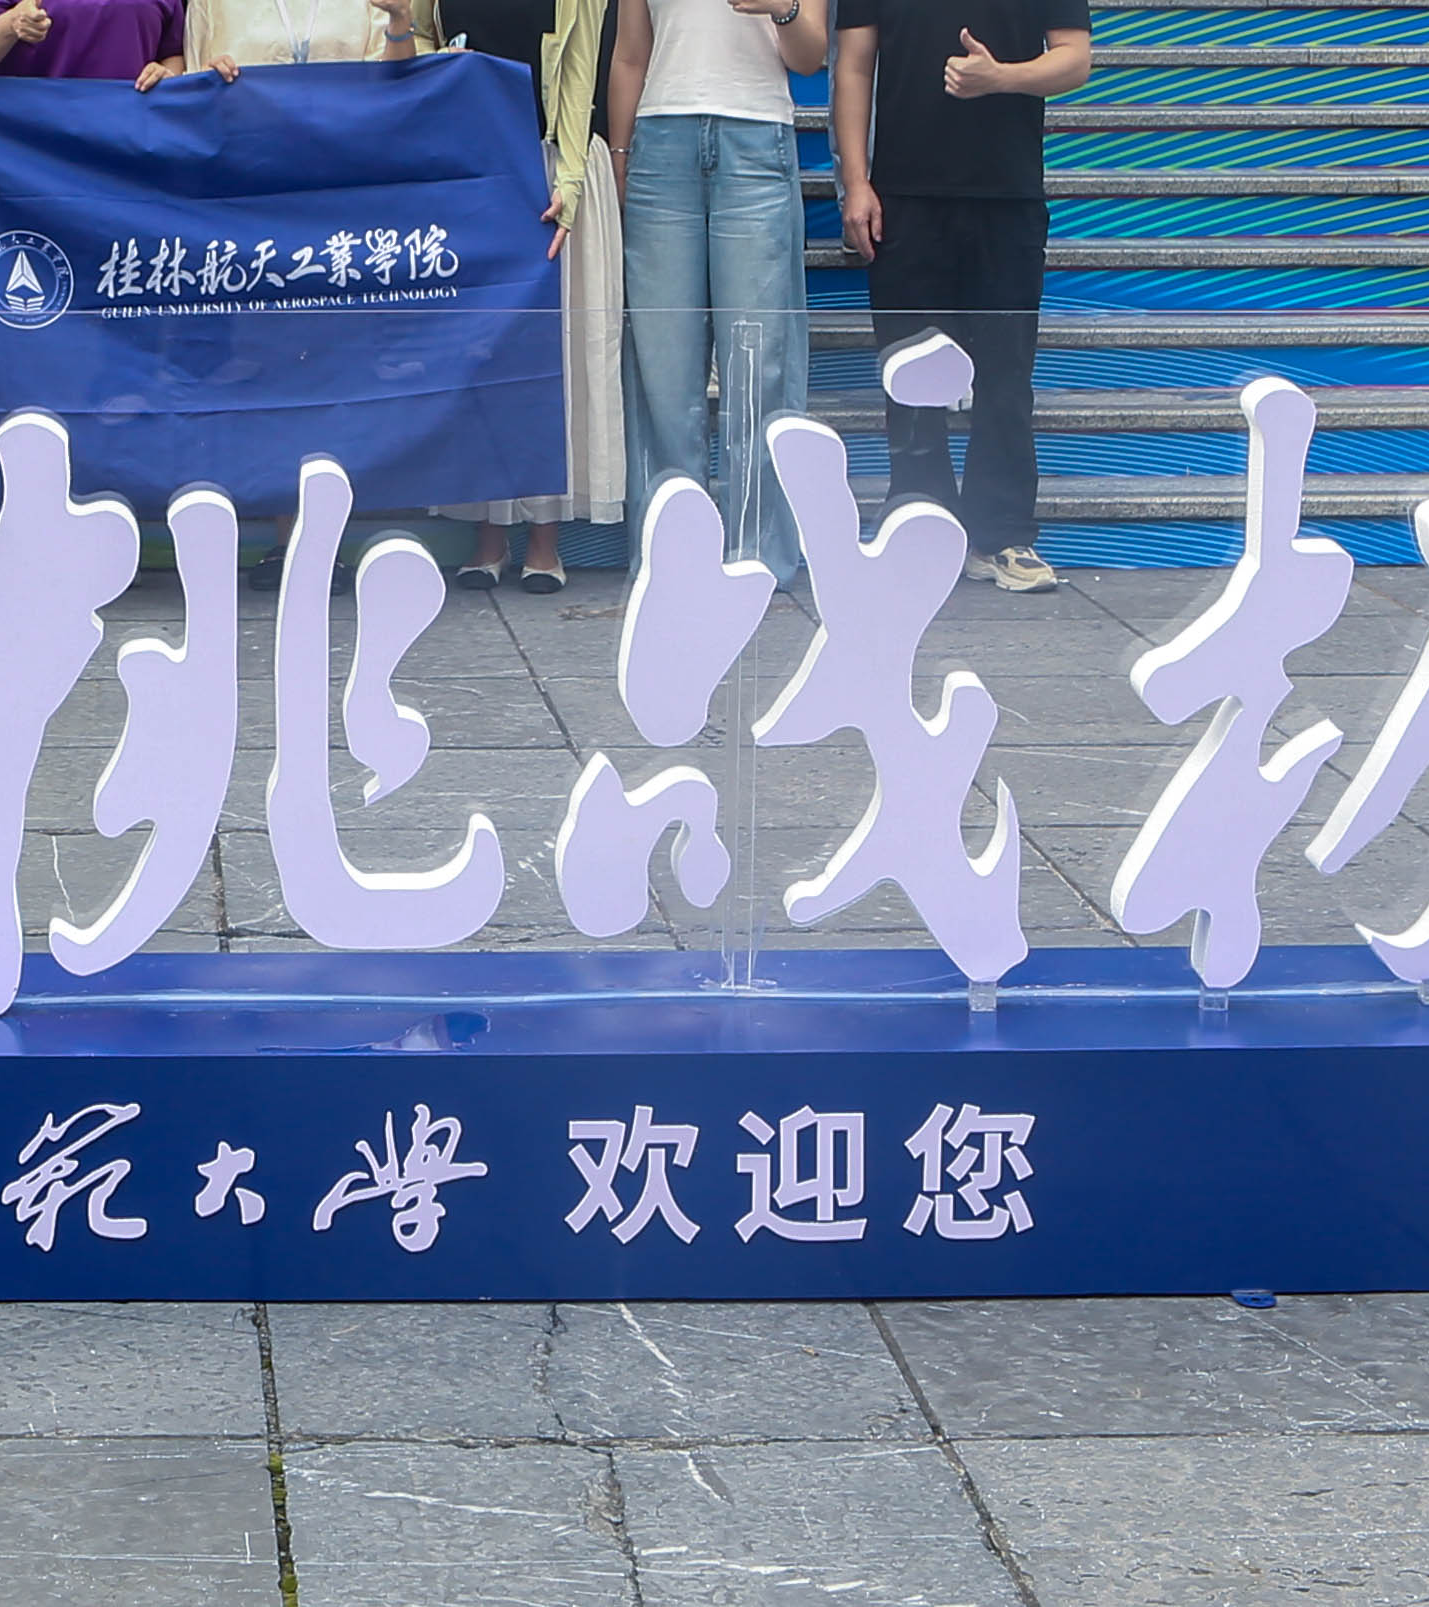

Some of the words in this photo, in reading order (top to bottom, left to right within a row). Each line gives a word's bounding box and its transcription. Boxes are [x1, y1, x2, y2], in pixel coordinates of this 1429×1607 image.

[101, 306, 151, 319] GUILIN
[157, 302, 242, 317] UNIVERSITY
[249, 300, 267, 311] OF
[273, 295, 355, 310] AEROSPACE
[362, 288, 460, 304] TECHNOLOGY
[564, 1102, 1036, 1243] 欢迎您
